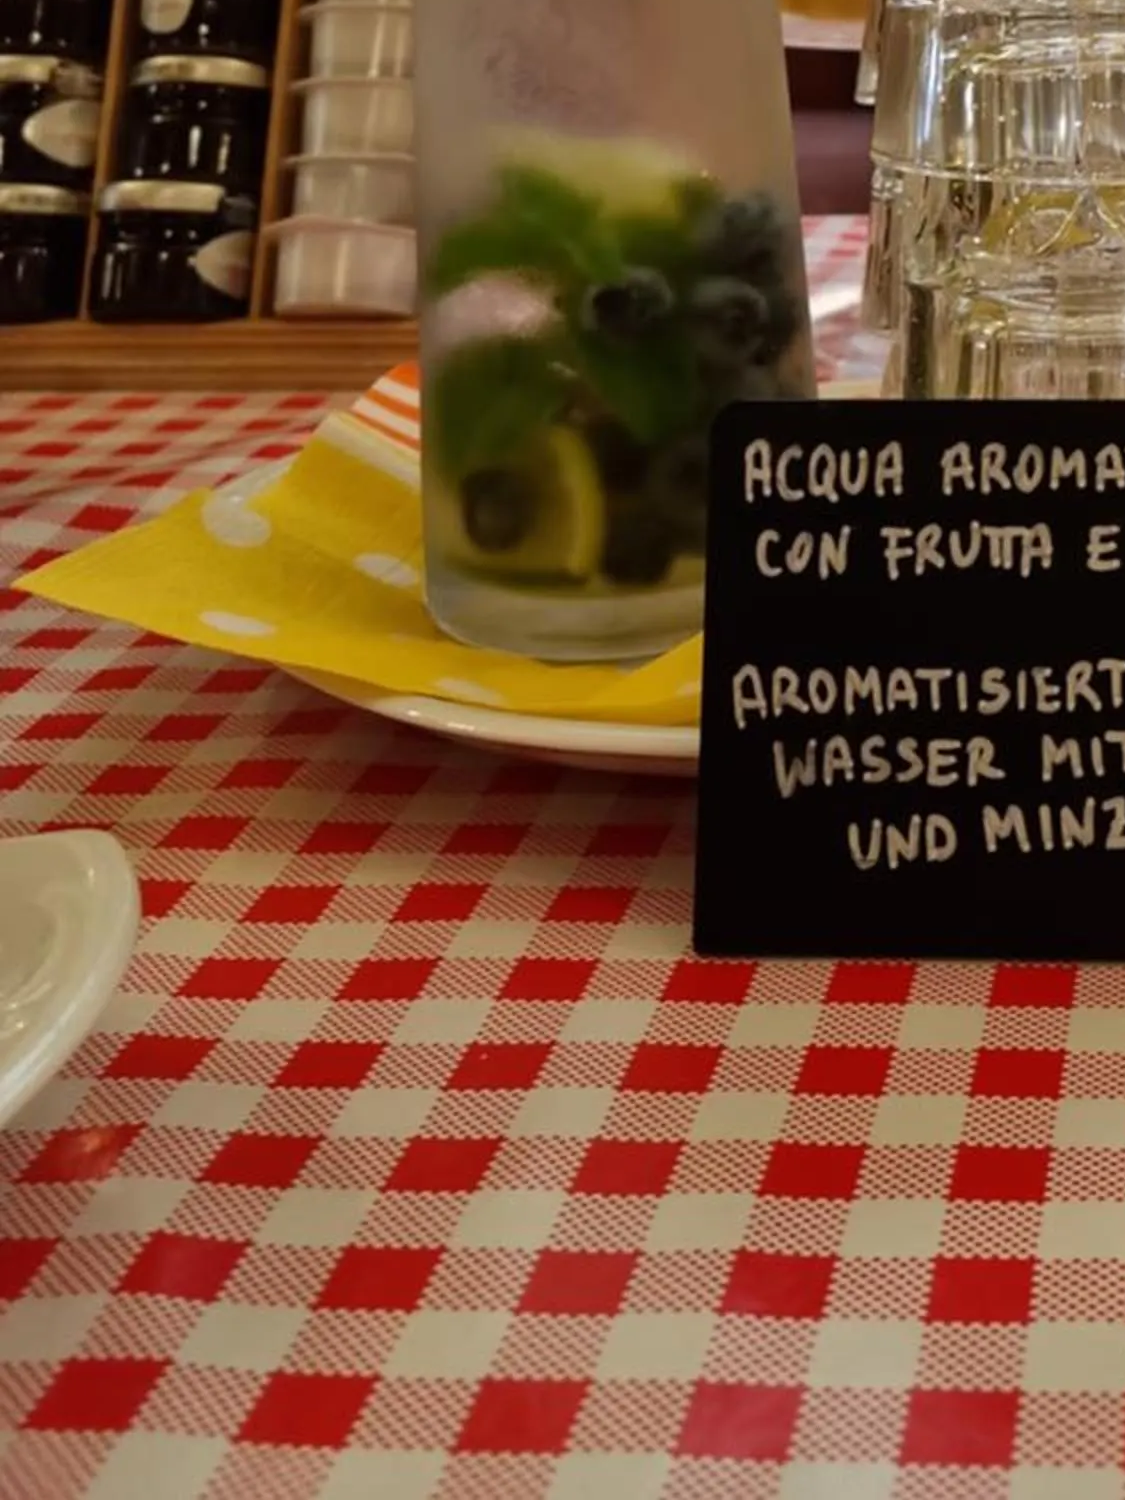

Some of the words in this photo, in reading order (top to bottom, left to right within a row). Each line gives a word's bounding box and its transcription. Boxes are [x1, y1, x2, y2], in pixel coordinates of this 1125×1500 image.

[745, 439, 903, 502] ACQUA
[757, 526, 850, 579] CON
[881, 521, 1053, 580] FRUTTA
[1087, 525, 1120, 571] E
[774, 736, 1005, 797] WASSER
[849, 814, 956, 869] UND
